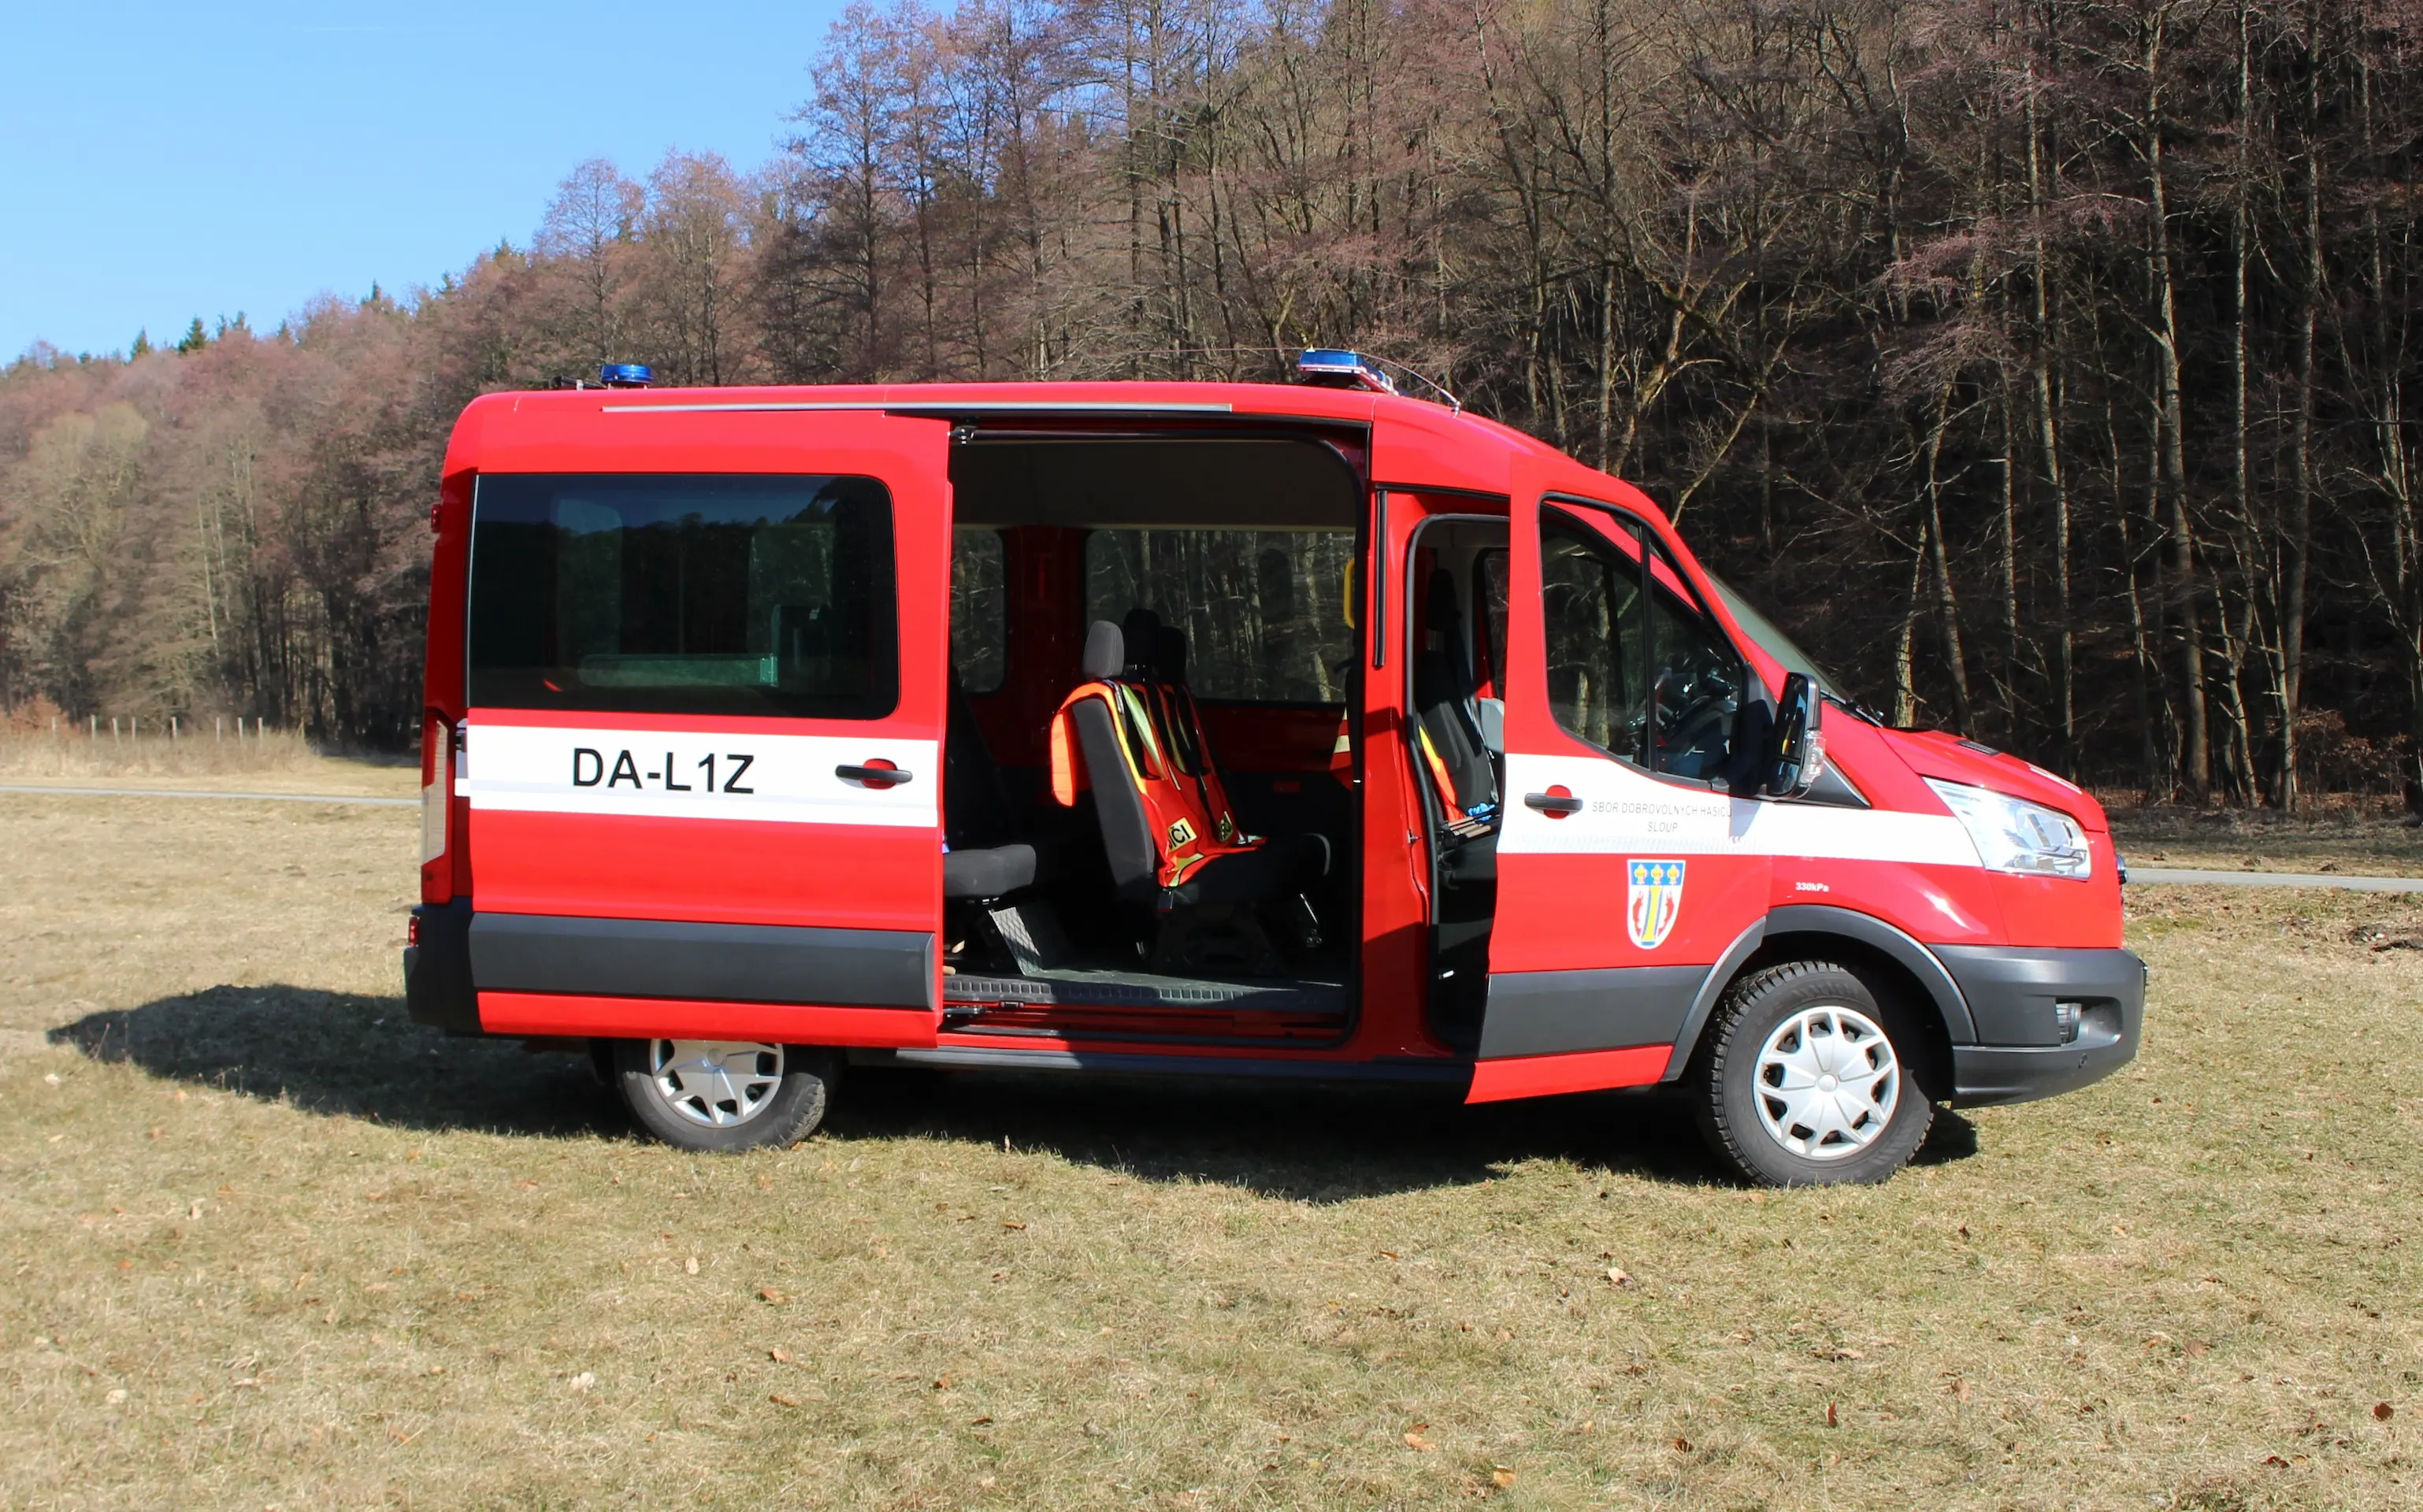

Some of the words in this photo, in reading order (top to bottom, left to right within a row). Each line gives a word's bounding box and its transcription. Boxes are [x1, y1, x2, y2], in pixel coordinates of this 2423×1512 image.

[573, 747, 754, 794] DA-L1Z
[1592, 801, 1619, 813] SBOR
[1647, 821, 1679, 832] SLOUP
[1795, 881, 1829, 892] 330kPa
